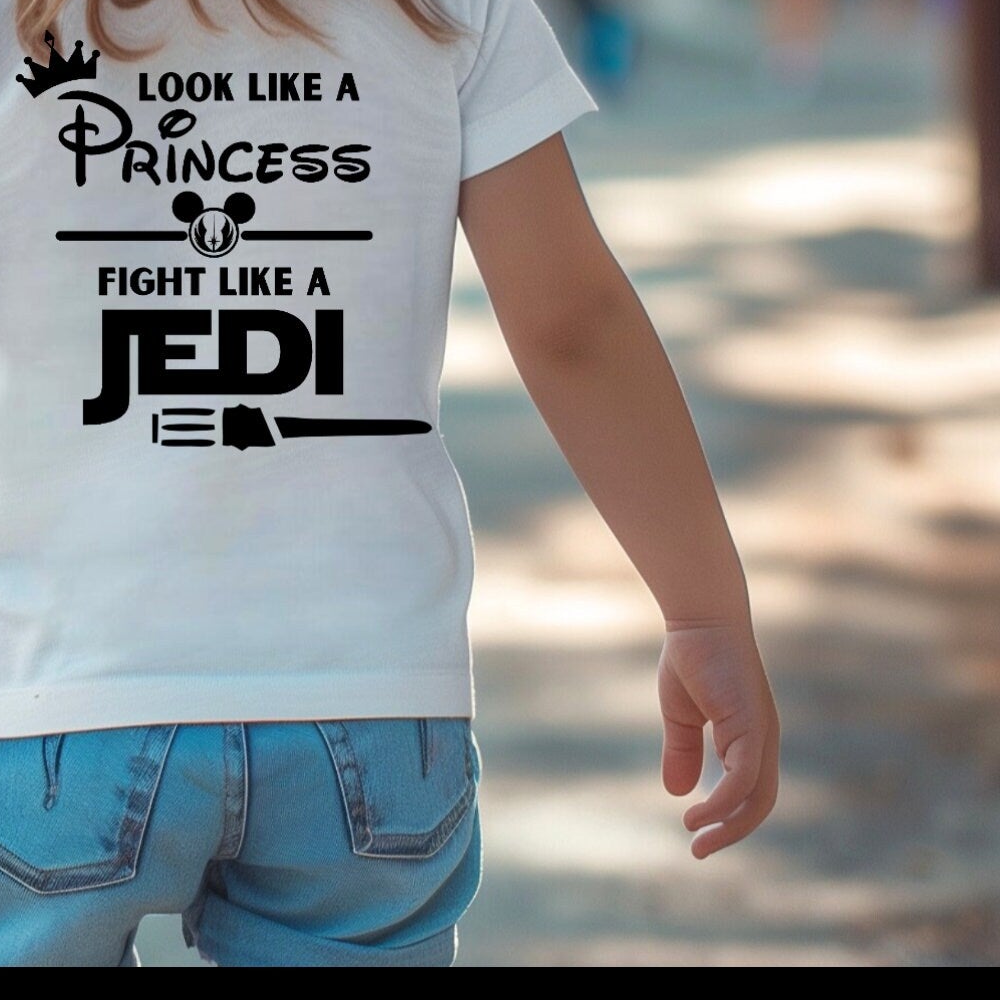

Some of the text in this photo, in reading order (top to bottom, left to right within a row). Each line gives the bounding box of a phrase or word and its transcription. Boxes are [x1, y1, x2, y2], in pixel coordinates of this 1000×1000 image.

[139, 72, 360, 102] LOOK LIKE A
[99, 267, 331, 296] FIGHT LIKE A
[82, 309, 344, 426] JEDI
